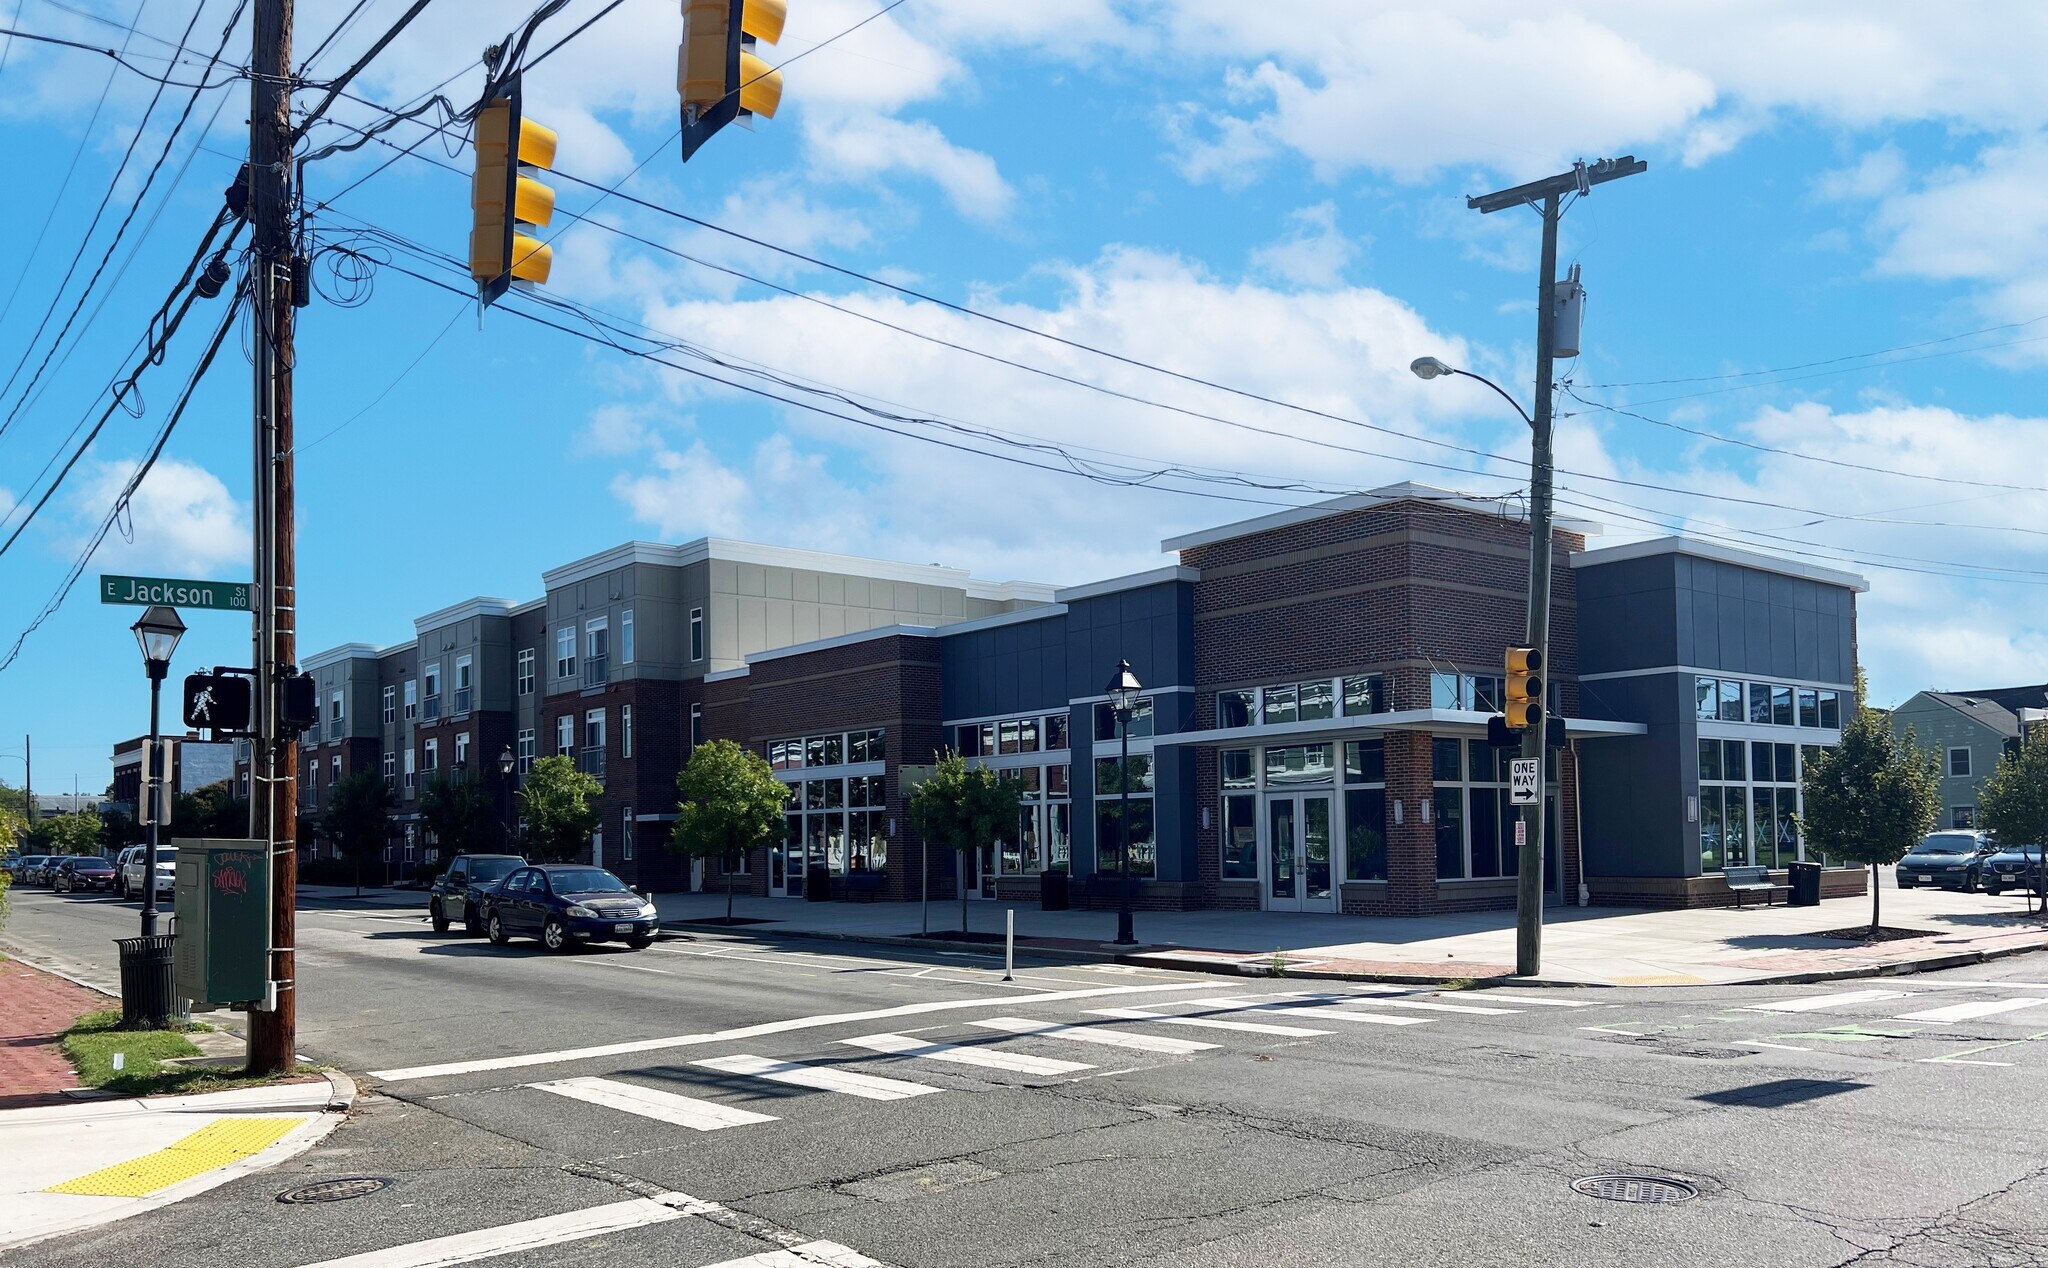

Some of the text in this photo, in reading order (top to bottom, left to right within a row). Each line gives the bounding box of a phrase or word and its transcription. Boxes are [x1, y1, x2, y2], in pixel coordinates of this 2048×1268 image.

[107, 580, 246, 605] E Jackson St
[229, 596, 246, 607] 100
[1514, 762, 1535, 773] ONE
[1513, 775, 1535, 786] WAY
